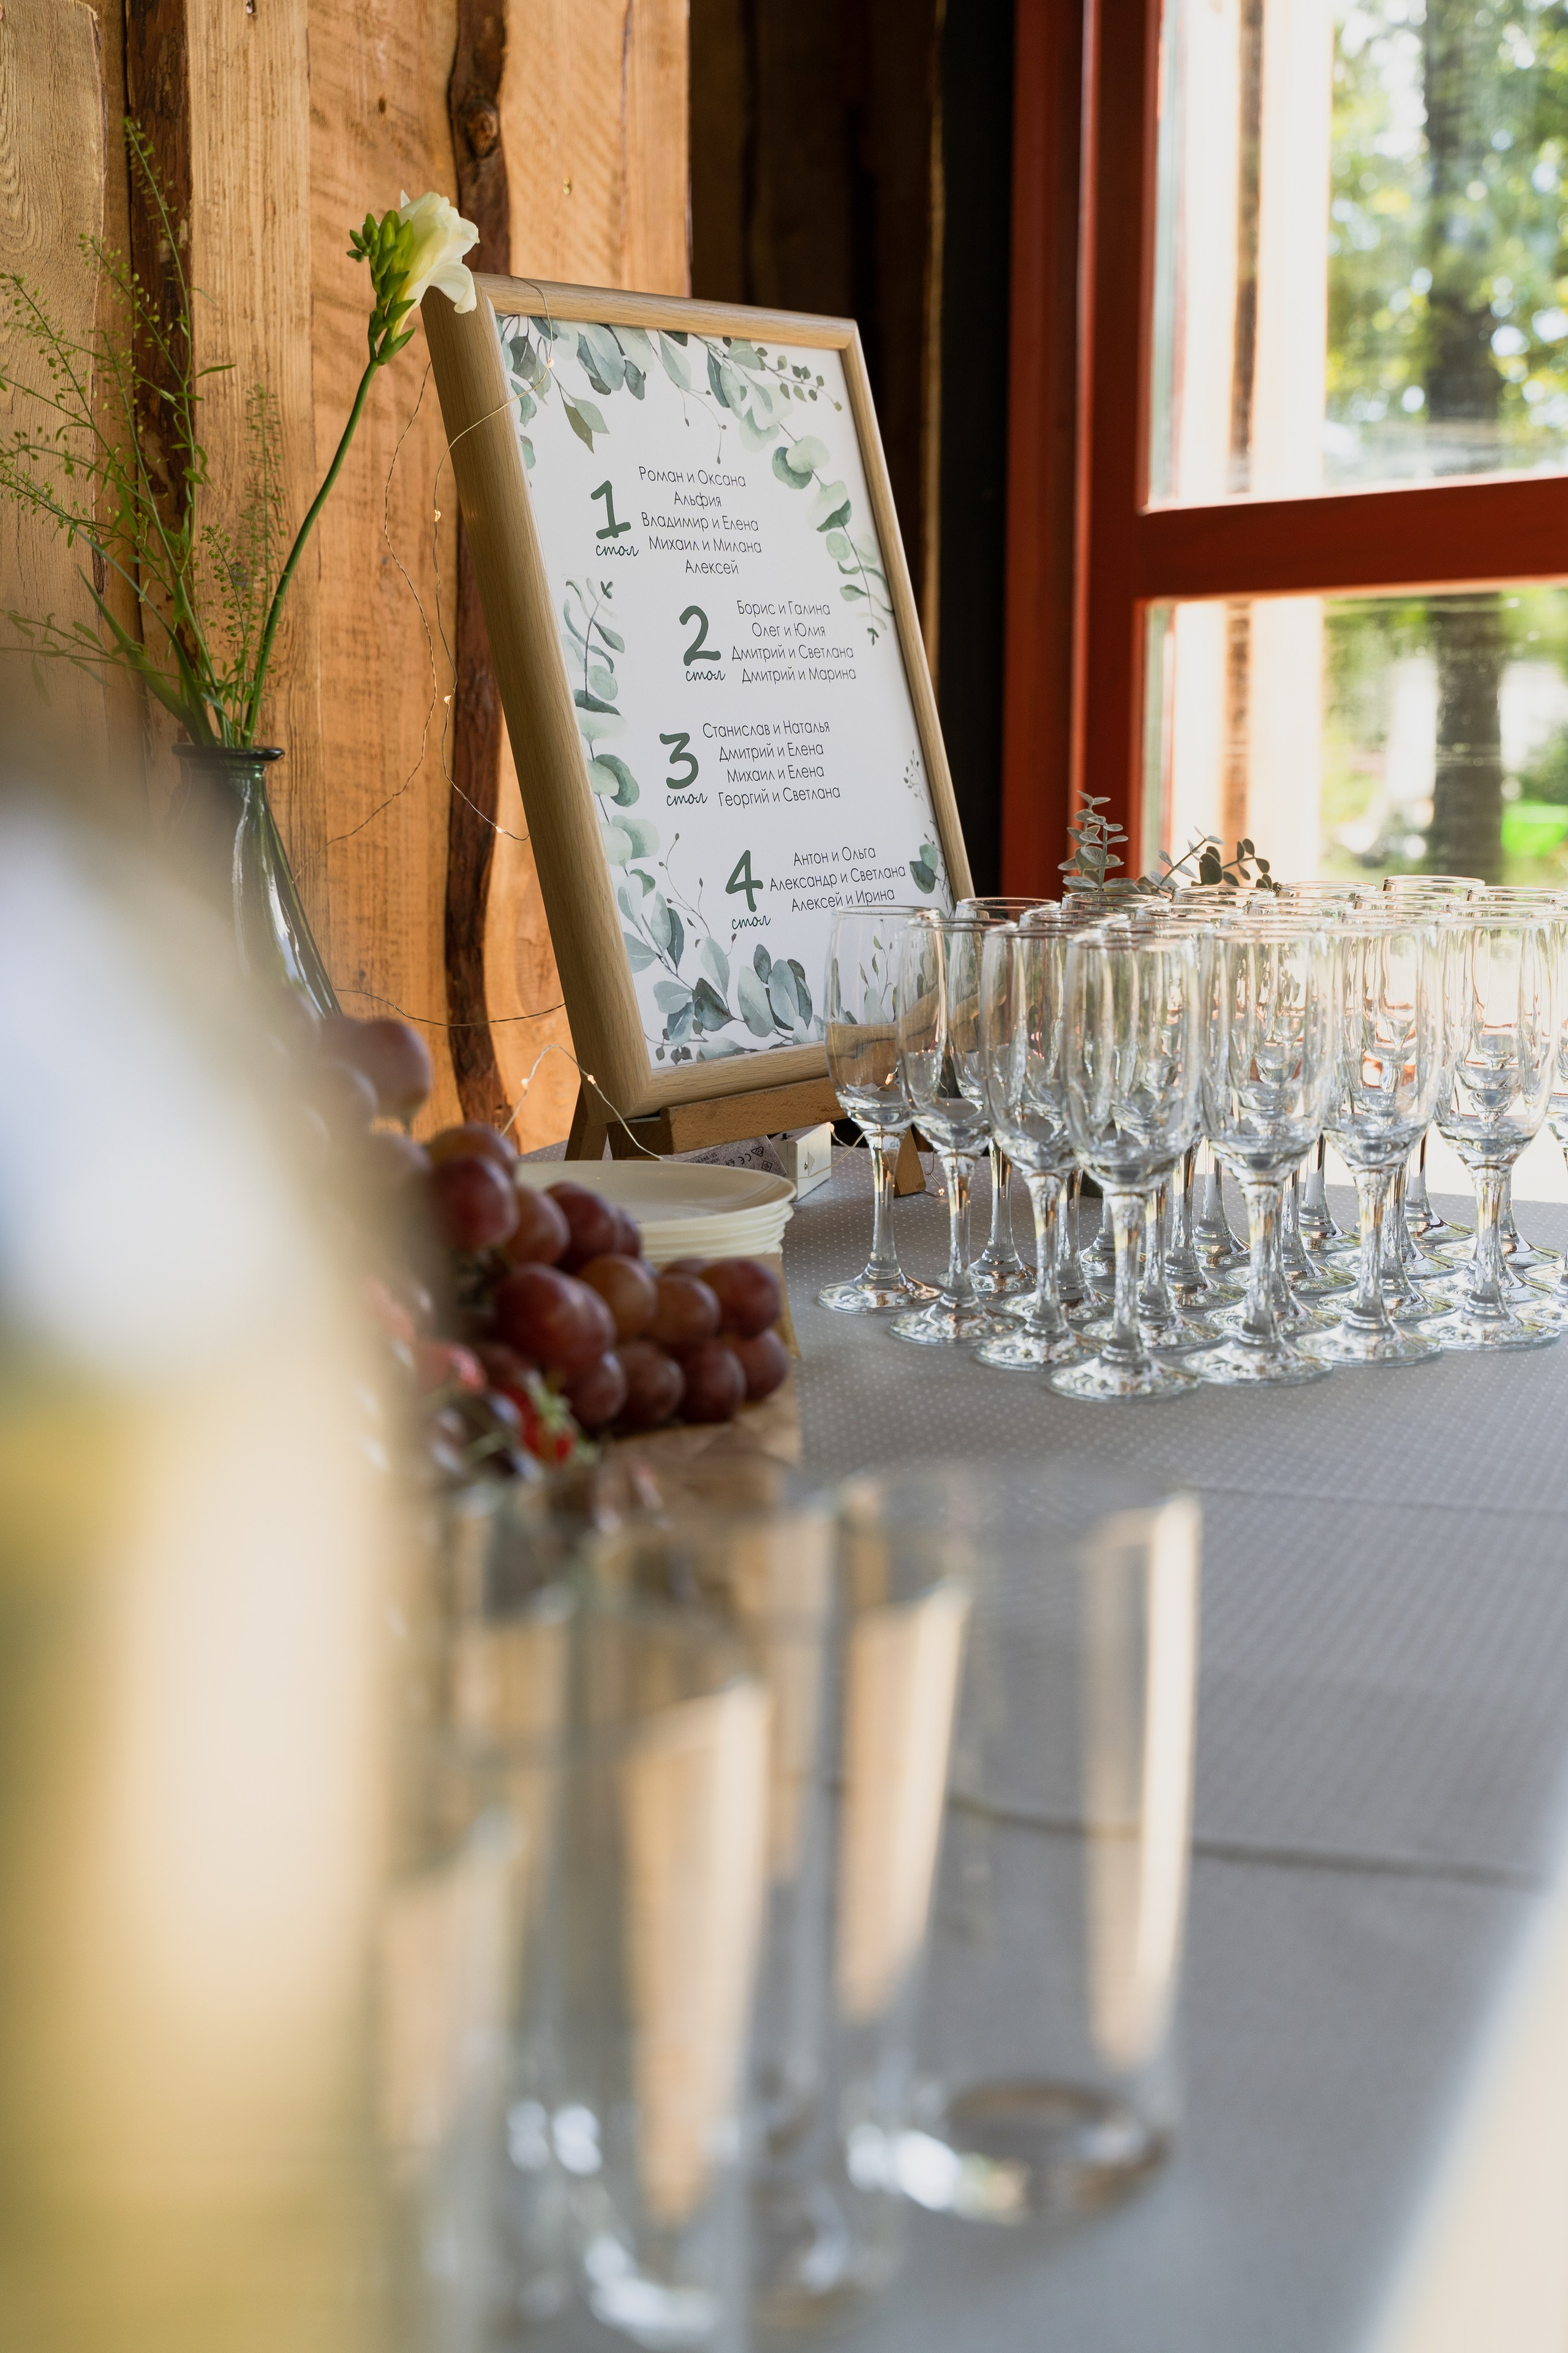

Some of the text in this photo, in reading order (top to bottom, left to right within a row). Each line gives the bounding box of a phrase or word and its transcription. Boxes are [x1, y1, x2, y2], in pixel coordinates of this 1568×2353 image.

[639, 466, 746, 487] Роман и Оксана
[674, 491, 722, 510] Альфия
[590, 480, 631, 540] 1
[641, 512, 759, 532] Владимир и Елена
[596, 545, 639, 557] стол
[649, 535, 762, 553] Михаил и Милана
[685, 559, 739, 574] Алексей
[737, 600, 831, 618] Борис и Галина
[679, 605, 722, 667] 2
[752, 622, 826, 637] Олег и Юлия
[732, 644, 854, 662] Дмитрий и Светлана
[686, 670, 726, 682] стол
[742, 667, 856, 685] Дмитрий и Марина
[703, 720, 830, 738] Станислав и Наталья
[659, 732, 699, 790] 3
[719, 742, 824, 763] Дмитрий и Елена
[727, 765, 824, 783] Михаил и Елена
[666, 793, 708, 806] стол
[718, 787, 840, 809] Георгий и Светлана
[794, 847, 876, 866] Антон и Ольга
[725, 850, 764, 912] 4
[770, 866, 906, 892] Александр и Светлана
[792, 889, 895, 913] Алексей и Ирина
[732, 915, 771, 930] стол
